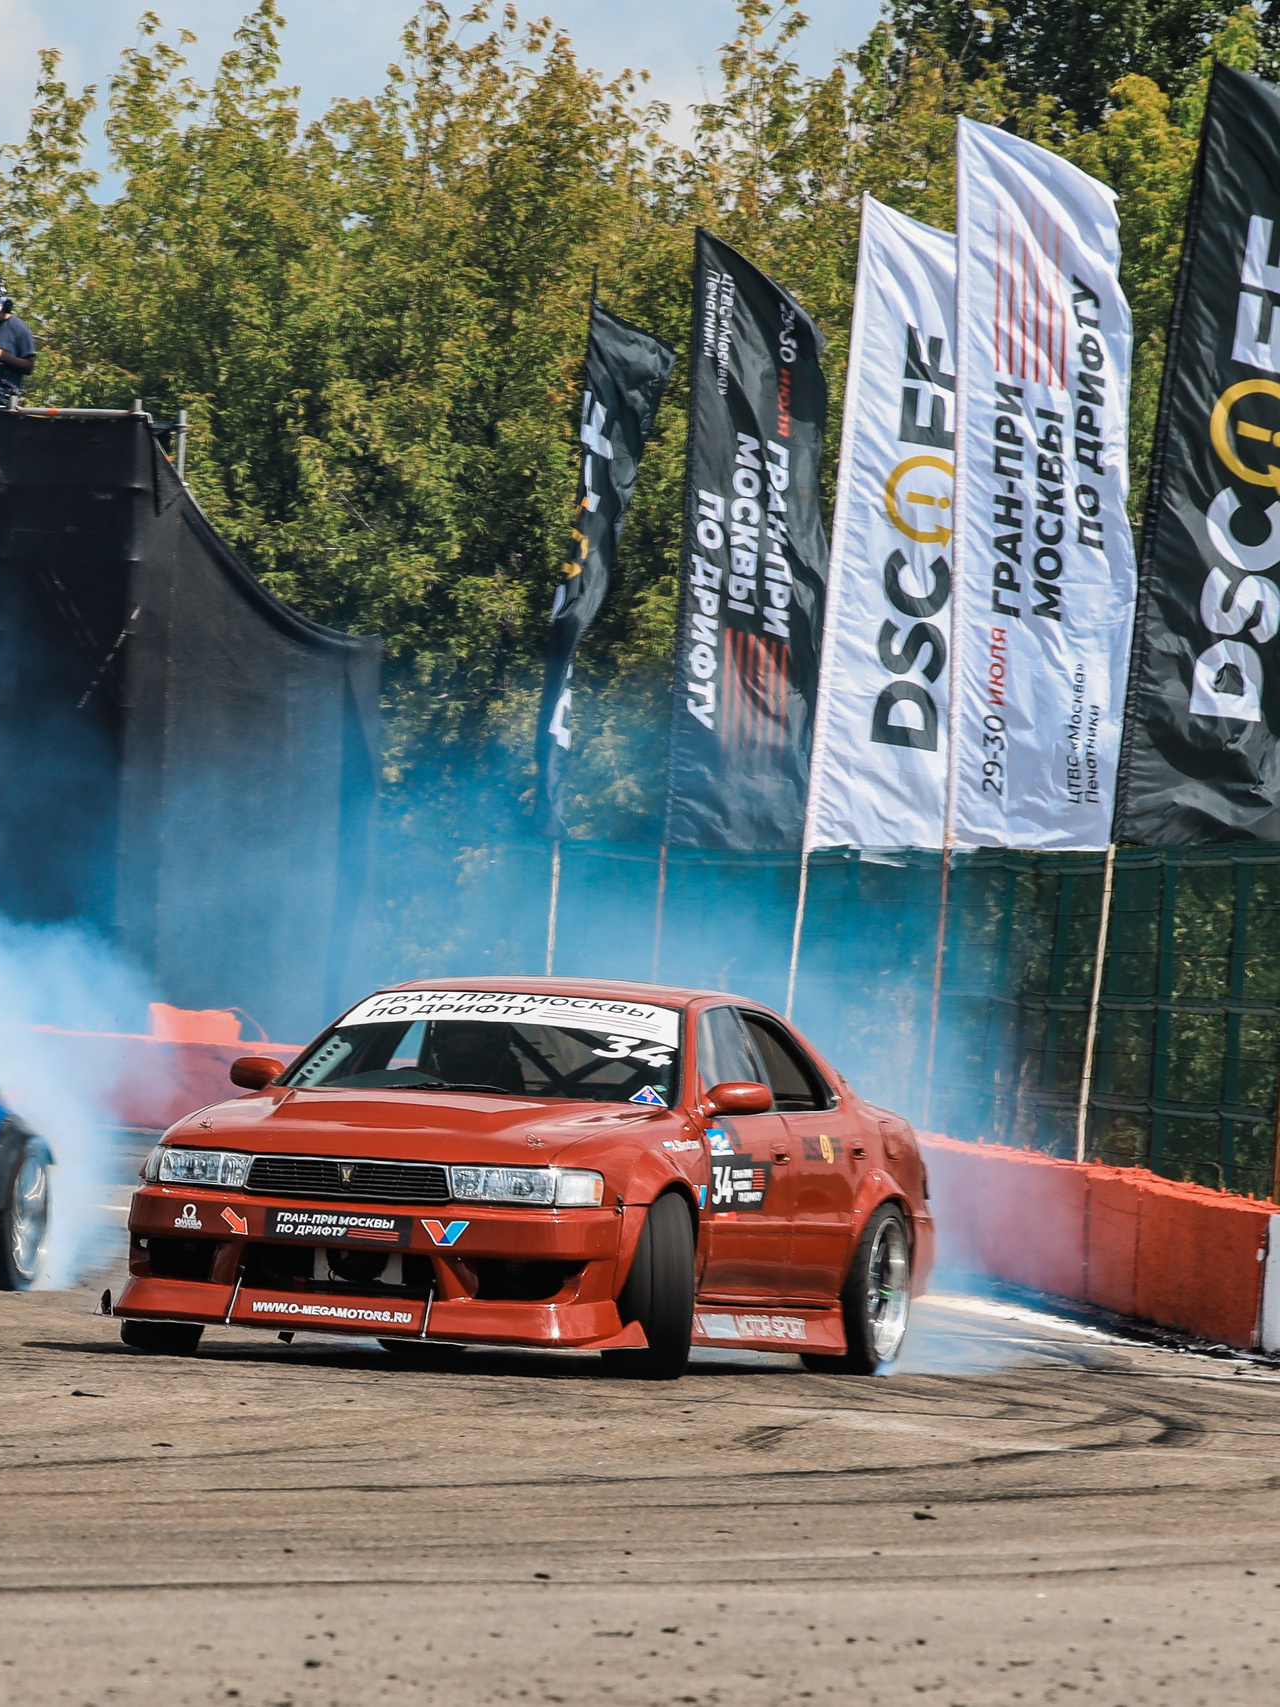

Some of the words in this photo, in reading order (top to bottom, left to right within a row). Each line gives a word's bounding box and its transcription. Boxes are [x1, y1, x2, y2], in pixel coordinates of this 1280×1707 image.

[1071, 273, 1106, 477] ДРИФТУ
[696, 489, 725, 550] ПО
[727, 431, 762, 615] МОСКВЫ
[991, 381, 1024, 618] ГРАН-ПРИ
[1032, 407, 1065, 622] МОСКВЫ
[1075, 483, 1105, 550] ПО
[763, 439, 793, 638] ГРАН-ПРИ
[687, 553, 723, 730] ДРИФТУ
[982, 714, 1006, 796] 29-30
[1084, 704, 1101, 804] Печатники
[365, 1005, 408, 1018] ПО
[410, 1003, 539, 1017] ДРИФТУ
[375, 993, 516, 1007] ГРАН-ПРИ
[522, 995, 656, 1019] МОСКВЫ
[590, 1035, 676, 1068] 34
[712, 1166, 733, 1205] 34
[275, 1224, 294, 1233] ПО
[295, 1225, 348, 1237] ДРИФТУ
[277, 1212, 337, 1225] ГРАН-ПРИ
[338, 1216, 395, 1229] МОСКВЫ
[252, 1301, 413, 1323] WWW.O-MEGAMOTORS.RU
